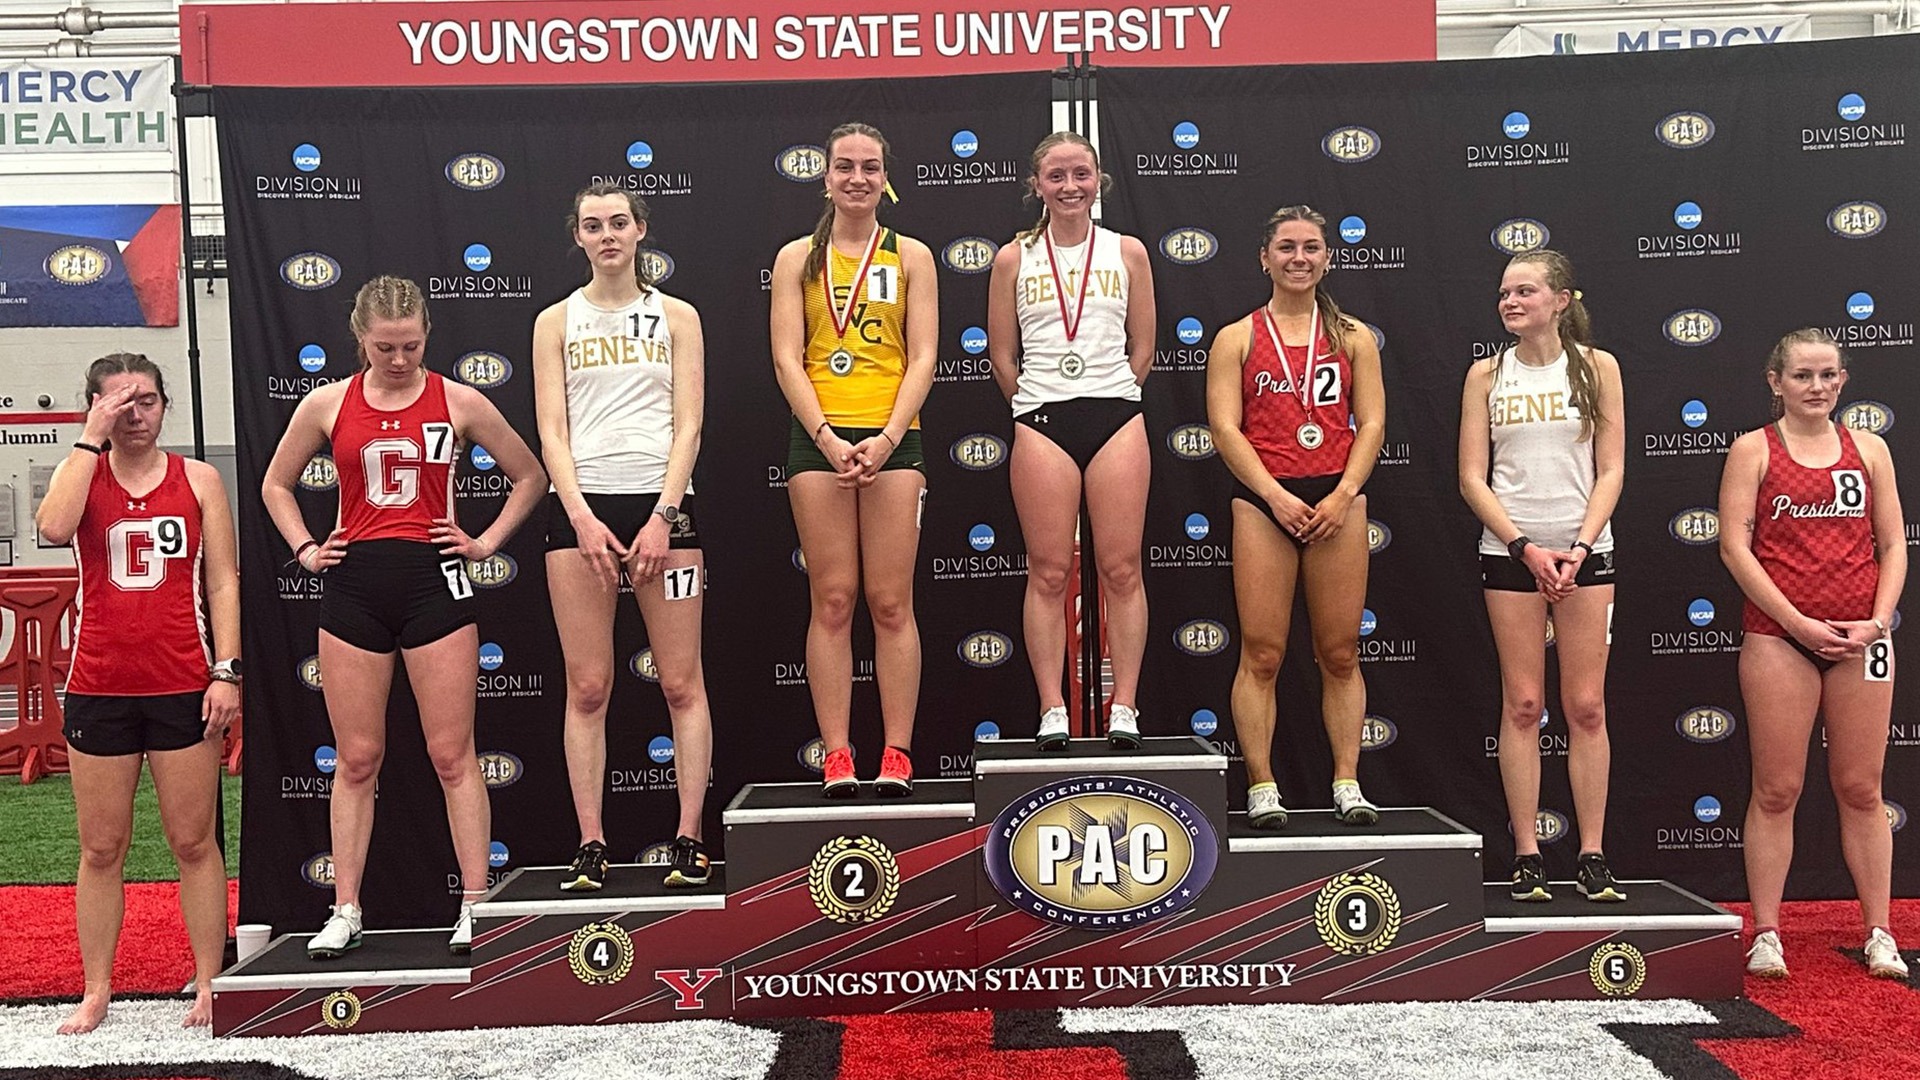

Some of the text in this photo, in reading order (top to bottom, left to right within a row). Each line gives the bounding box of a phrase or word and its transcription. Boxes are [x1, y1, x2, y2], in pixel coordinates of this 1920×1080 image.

[399, 5, 1230, 64] YOUNGSTOWN STATE UNIVERSITY
[1841, 106, 1865, 115] NCAA
[1506, 124, 1529, 133] NCAA
[1668, 123, 1702, 139] PAC
[1802, 124, 1904, 143] DIVISION III
[1176, 134, 1199, 142] NCAA
[1334, 138, 1368, 153] PAC
[954, 142, 978, 151] NCAA
[1468, 142, 1568, 160] DIVISION III
[296, 157, 320, 165] NCAA
[630, 154, 652, 162] NCAA
[788, 156, 820, 171] PAC
[1136, 153, 1237, 169] DIVISION III
[458, 164, 492, 181] PAC
[917, 161, 1016, 178] DIVISION III
[256, 177, 361, 192] DIVISION III
[678, 173, 691, 188] III
[1678, 214, 1701, 223] NCAA
[1840, 212, 1874, 228] PAC
[1342, 228, 1365, 236] NCAA
[1504, 230, 1536, 245] PAC
[1172, 239, 1203, 255] PAC
[1638, 232, 1740, 250] DIVISION III
[467, 256, 491, 265] NCAA
[955, 248, 988, 264] PAC
[1391, 248, 1405, 262] III
[58, 256, 97, 275] PAC
[295, 264, 327, 280] PAC
[430, 276, 531, 292] DIVISION III
[872, 267, 887, 300] 1
[1850, 305, 1874, 313] NCAA
[629, 313, 660, 340] 17
[1676, 321, 1709, 336] PAC
[1812, 324, 1913, 341] IVISION III
[964, 339, 986, 347] NCAA
[302, 357, 326, 366] NCAA
[1154, 350, 1207, 364] IVISIO
[466, 363, 499, 379] PAC
[934, 359, 991, 375] IVISIO
[1318, 368, 1336, 400] 2
[1490, 391, 1564, 426] GENE
[1684, 412, 1707, 421] NCAA
[1847, 413, 1880, 430] PAC
[426, 426, 448, 460] 7
[1178, 435, 1210, 451] PAC
[1645, 433, 1726, 448] DIVISION
[962, 446, 996, 460] PAC
[1396, 444, 1409, 457] III
[303, 465, 334, 481] PAC
[361, 439, 421, 508] G
[1839, 472, 1862, 508] 8
[1682, 520, 1717, 536] PAC
[158, 520, 182, 554] 9
[972, 536, 994, 544] NCAA
[106, 520, 167, 590] G
[1151, 546, 1227, 560] DIVISION
[472, 562, 504, 578] PAC
[933, 555, 1028, 572] DIVISION III
[278, 578, 323, 592] DIVISI
[446, 563, 466, 595] 7
[667, 568, 695, 597] 17
[1186, 630, 1218, 646] PAC
[1652, 632, 1732, 647] DIVISION
[971, 642, 1000, 658] PAC
[1402, 640, 1415, 653] III
[480, 656, 502, 664] NCAA
[860, 661, 872, 674] III
[1870, 644, 1888, 679] 8
[528, 675, 542, 688] III
[1689, 718, 1722, 734] PAC
[1362, 728, 1384, 742] AC
[651, 748, 674, 756] NCAA
[282, 776, 332, 792] DIVISI
[612, 770, 676, 785] DIVISIO
[1004, 781, 1198, 837] PRESIDENTS' ATHLETIC
[1535, 820, 1556, 835] AC
[1658, 828, 1738, 842] DIVISION
[1038, 824, 1166, 884] PAC
[315, 863, 336, 878] PA
[843, 864, 864, 896] 2
[1033, 899, 1175, 924] CONFERENCE
[1348, 899, 1367, 930] 3
[593, 942, 608, 966] 4
[1611, 959, 1624, 980] 5
[656, 968, 722, 1009] Y
[744, 963, 1296, 998] YOUNGSTOWN STATE UNIVERSITY
[336, 1002, 346, 1017] 6
